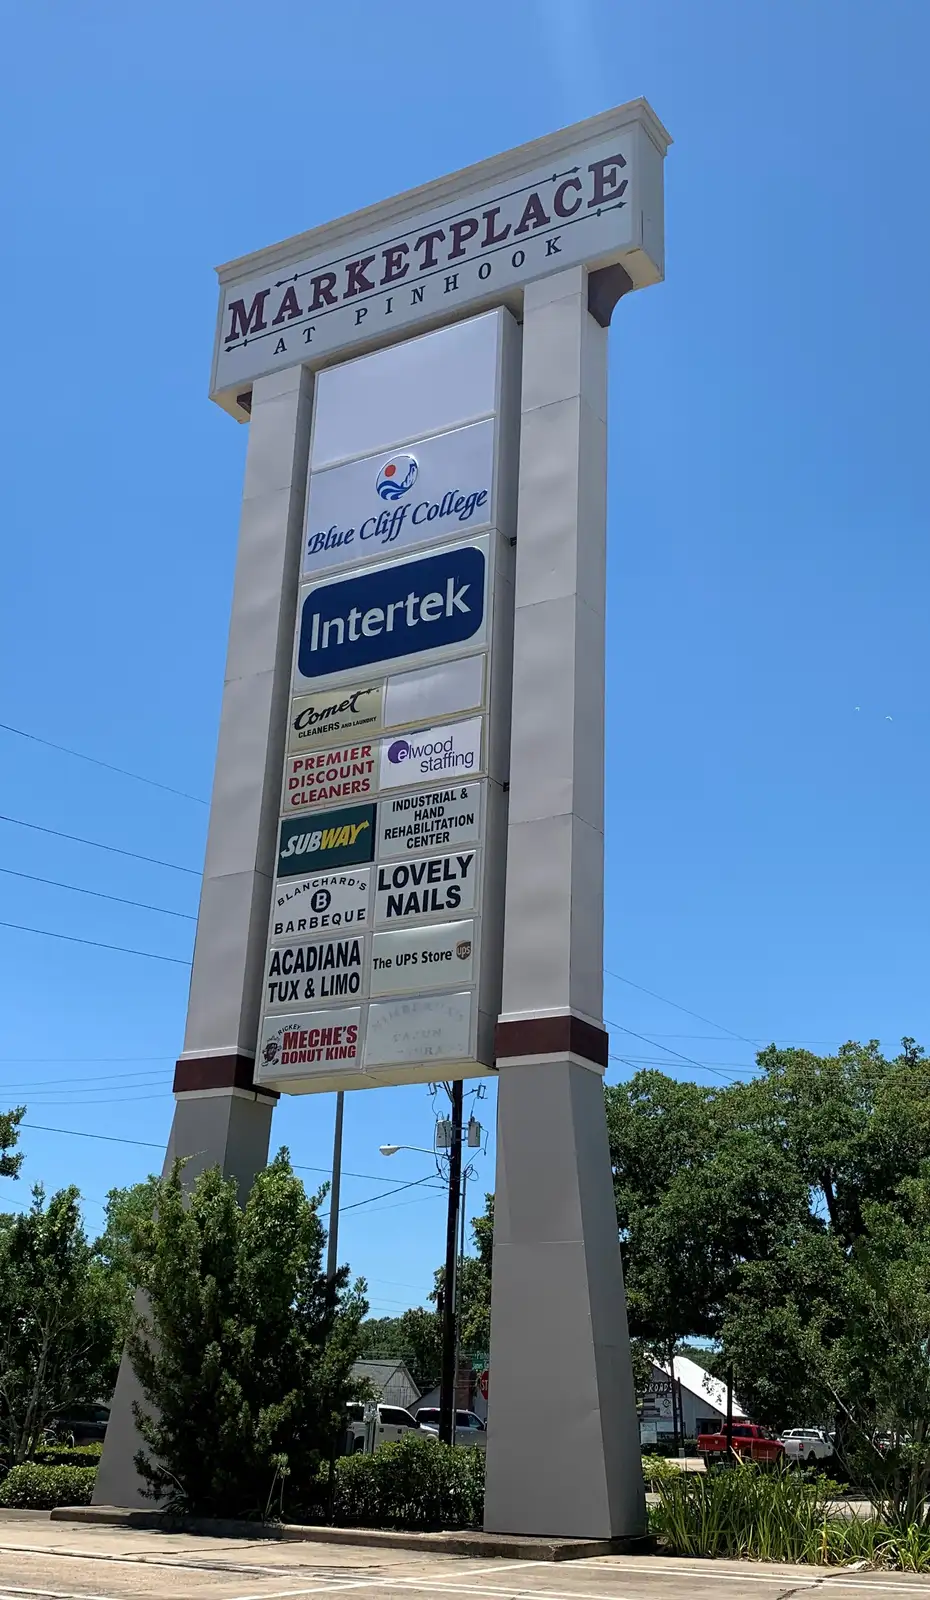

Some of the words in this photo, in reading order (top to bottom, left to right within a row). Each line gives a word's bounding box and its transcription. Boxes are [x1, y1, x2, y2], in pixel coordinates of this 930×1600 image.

[224, 153, 629, 343] MARKETPLACE
[273, 327, 319, 355] AT
[354, 235, 563, 326] PINHOOK
[307, 525, 356, 555] Blue
[359, 503, 412, 544] Cliff
[411, 488, 488, 525] College
[310, 577, 472, 652] Intertek
[293, 687, 380, 731] Comet
[298, 721, 340, 739] CLEANERS
[353, 716, 378, 727] LAUNDRY
[292, 745, 372, 773] PREMIER
[396, 736, 453, 762] elwood
[420, 750, 475, 774] staffing
[288, 760, 375, 790] DISCOUNT
[290, 778, 371, 806] CLEANERS
[392, 789, 457, 812] INDUSTRIAL
[460, 787, 469, 800] &
[384, 813, 475, 840] REHABILITATION
[414, 806, 445, 822] HAND
[280, 820, 370, 858] SUBWAY
[406, 831, 450, 850] CENTER
[377, 854, 474, 891] LOVELY
[277, 877, 367, 907] BLANCHARD'S
[385, 885, 462, 918] NAILS
[274, 908, 366, 935] BARBEQUE
[268, 939, 361, 977] ACADIANA
[373, 956, 392, 970] The
[395, 952, 418, 967] UPS
[421, 950, 452, 964] Store
[456, 944, 472, 957] ups
[268, 979, 300, 1003] TUX
[304, 978, 315, 999] &
[320, 972, 360, 998] LIMO
[277, 1023, 302, 1035] RICKEY
[282, 1025, 358, 1050] MECHE'S
[392, 1028, 442, 1043] CAUN
[281, 1048, 324, 1065] DONUT
[325, 1045, 357, 1061] KING
